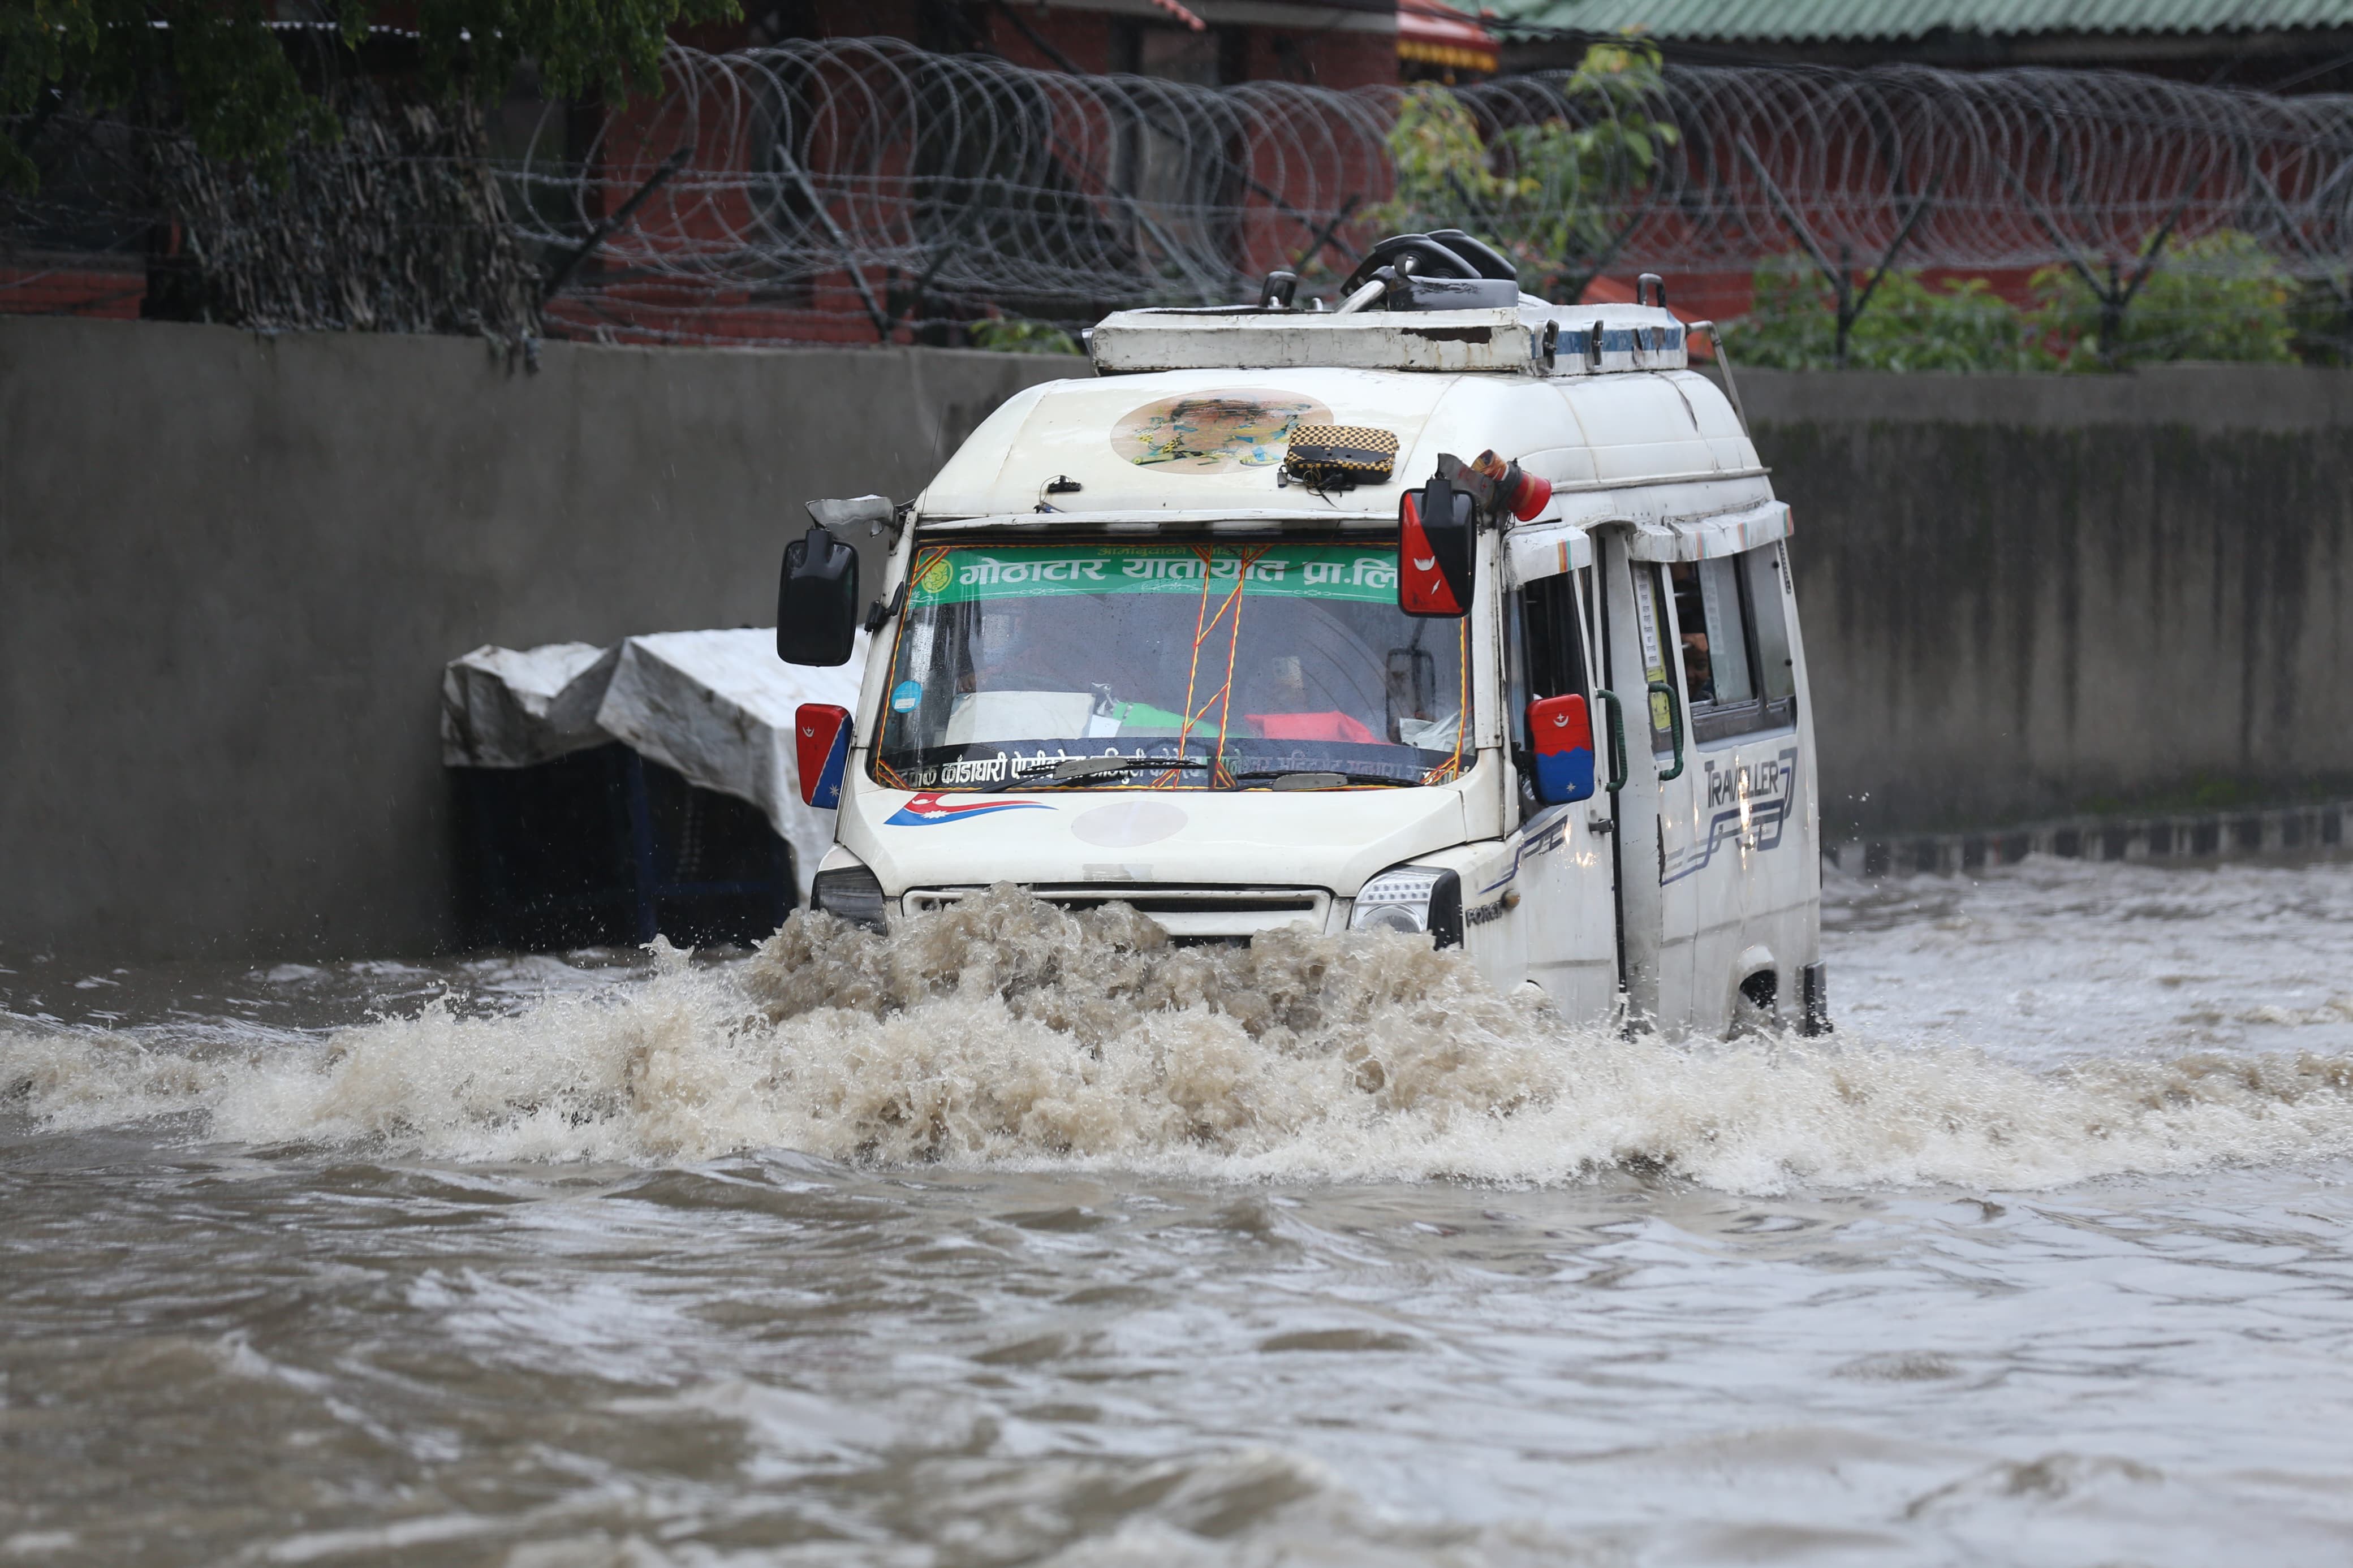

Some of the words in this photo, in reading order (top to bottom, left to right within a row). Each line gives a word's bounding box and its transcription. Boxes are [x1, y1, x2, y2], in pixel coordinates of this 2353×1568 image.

[959, 558, 1111, 585] गोठाटार
[1122, 558, 1290, 581] यातायात
[1705, 761, 1778, 808] TRAVELLER
